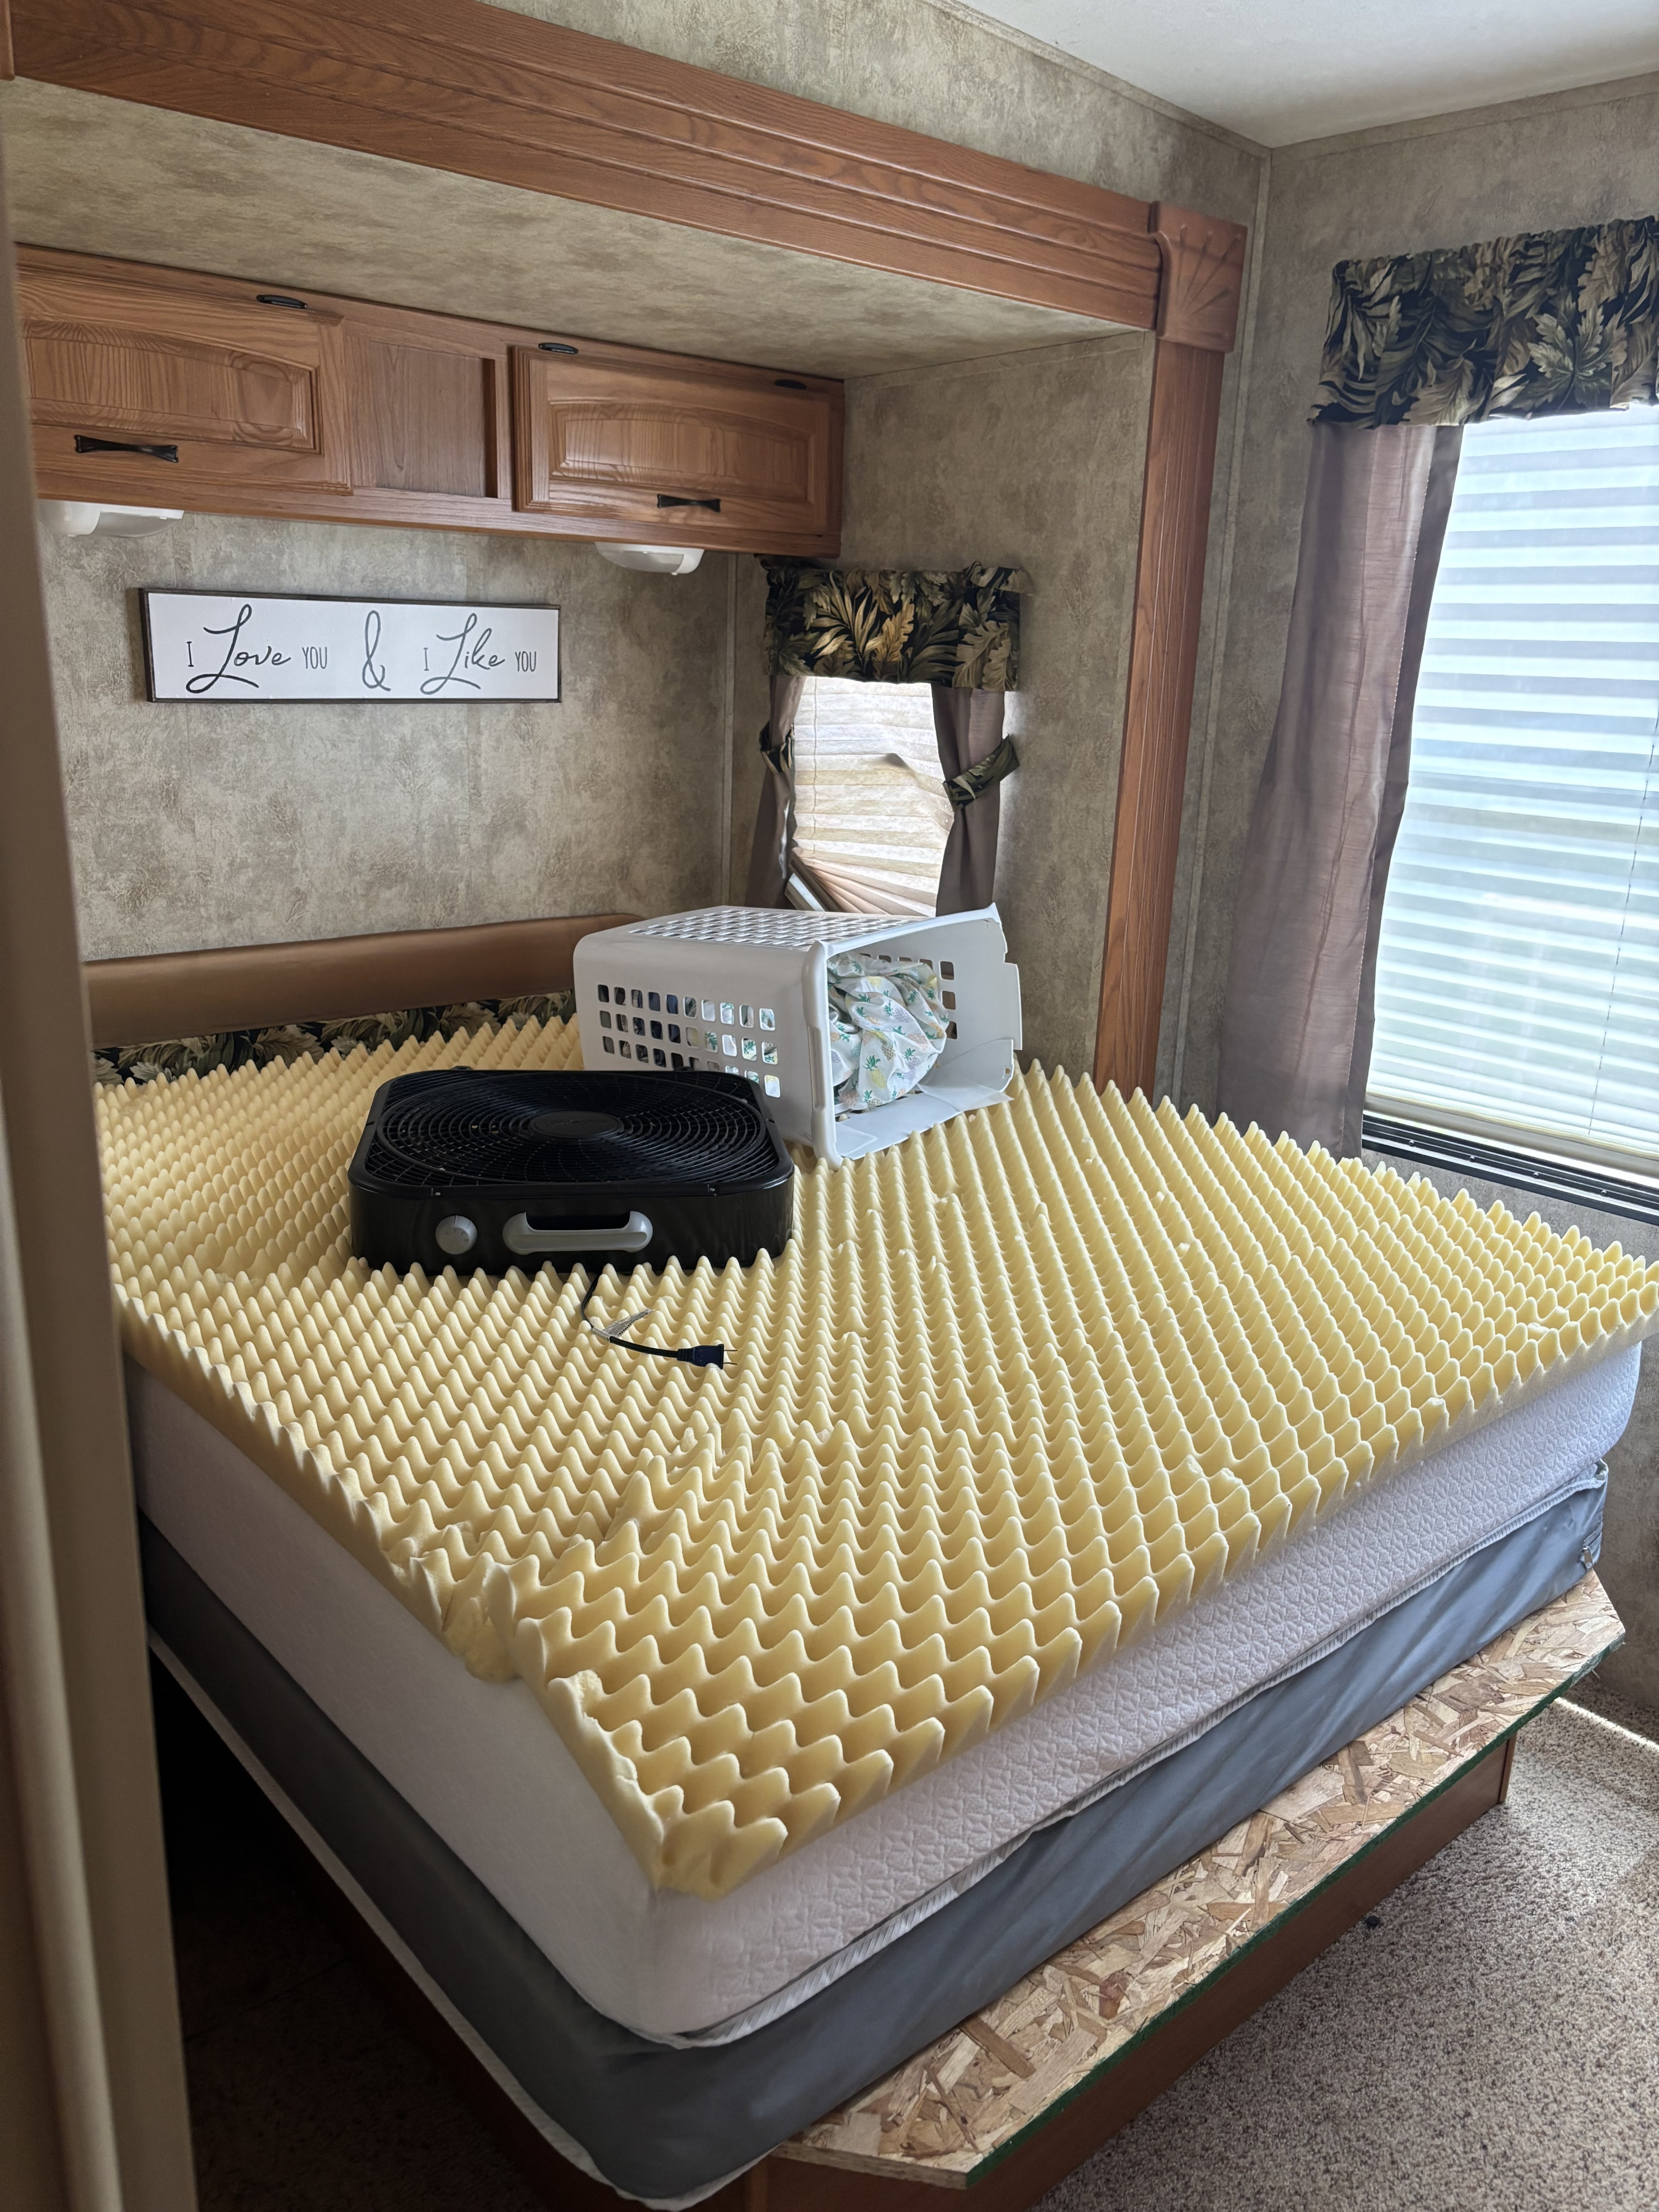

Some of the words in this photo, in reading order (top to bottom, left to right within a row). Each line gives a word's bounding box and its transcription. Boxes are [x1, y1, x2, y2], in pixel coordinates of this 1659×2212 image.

[185, 603, 292, 694] Love
[186, 641, 195, 667] I
[301, 646, 328, 670] YOU
[362, 609, 392, 692] &
[420, 612, 506, 695] Like
[423, 647, 430, 671] I
[514, 650, 537, 672] YOU
